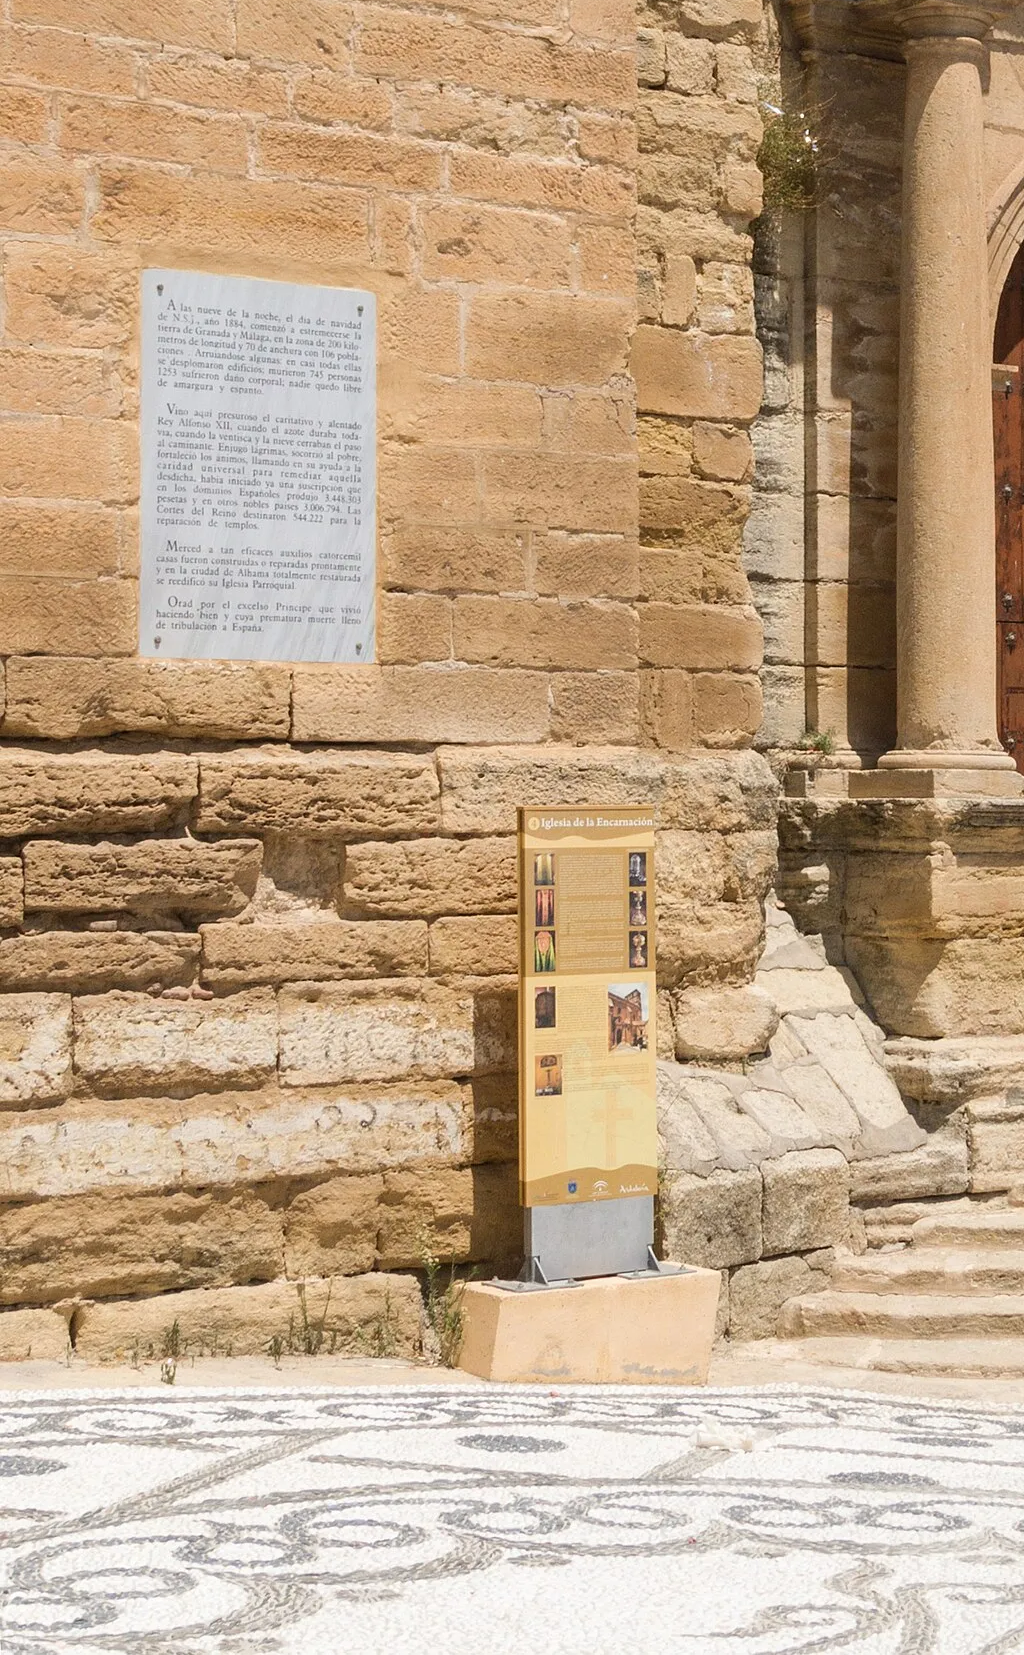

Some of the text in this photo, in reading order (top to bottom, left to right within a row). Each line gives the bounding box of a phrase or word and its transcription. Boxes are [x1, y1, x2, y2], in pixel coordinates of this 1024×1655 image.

[167, 299, 362, 330] A las nueve de la noche, el de navidad
[157, 312, 168, 321] de
[299, 329, 350, 339] estremecerse
[354, 332, 362, 340] la
[158, 324, 181, 333] tierra
[195, 326, 231, 338] Granada
[286, 336, 293, 344] la
[328, 340, 342, 348] 200
[344, 341, 362, 350] kilo-
[157, 336, 186, 345] metros
[201, 338, 236, 349] longitud
[246, 342, 256, 350] 70
[257, 344, 267, 352] de
[270, 346, 302, 356] anchura
[322, 350, 335, 358] 106
[337, 352, 362, 361] pobla-
[170, 358, 224, 370] desplomaron
[227, 363, 264, 374] edificios;
[268, 368, 306, 377] murieron
[310, 370, 324, 379] 745
[328, 374, 362, 382] personas
[319, 361, 340, 369] todas
[344, 363, 362, 372] ellas
[157, 378, 168, 387] de
[174, 382, 214, 391] amargura
[158, 367, 177, 376] 1253
[182, 370, 220, 380] sufrieron
[248, 377, 285, 387] corporal;
[288, 380, 311, 388] nadie
[343, 384, 362, 393] libre
[167, 403, 189, 415] Vino
[218, 412, 258, 421] presuroso
[262, 414, 270, 422] el
[275, 417, 314, 426] caritativo
[328, 420, 362, 430] alentado
[157, 416, 174, 427] Rey
[179, 418, 211, 428] Alfonso
[237, 424, 267, 432] cuando
[271, 425, 279, 434] el
[309, 427, 337, 438] duraba
[342, 432, 361, 440] toda-
[175, 430, 206, 439] cuando
[219, 434, 252, 442] ventisca
[262, 435, 270, 444] la
[296, 440, 332, 448] cerraban
[157, 439, 165, 447] al
[326, 452, 334, 460] al
[337, 451, 362, 462] pobre,
[200, 453, 212, 461] los
[252, 456, 290, 467] llamando
[319, 463, 343, 471] ayuda
[157, 462, 193, 471] caridad
[201, 466, 245, 474] universal
[280, 471, 321, 480] remediar
[329, 474, 362, 483] aquella
[157, 472, 196, 482] desdicha,
[228, 478, 262, 486] iniciado
[265, 481, 275, 489] ya
[174, 483, 186, 492] los
[193, 485, 232, 494] dominios
[286, 492, 318, 502] produjo
[156, 504, 184, 514] Cortes
[191, 507, 205, 516] del
[212, 508, 237, 518] Reino
[243, 510, 286, 521] destinaron
[354, 517, 362, 526] la
[157, 496, 187, 504] pesetas
[243, 500, 269, 508] nobles
[347, 506, 362, 515] Las
[208, 519, 218, 527] de
[166, 540, 202, 553] Merced
[241, 546, 274, 556] eficaces
[280, 549, 313, 558] auxilios
[319, 552, 362, 561] catorcemil
[181, 555, 208, 564] fueron
[269, 560, 308, 569] reparadas
[311, 563, 361, 572] prontamente
[191, 567, 220, 576] ciudad
[223, 568, 234, 576] de
[238, 568, 269, 578] Alhama
[273, 571, 316, 580] totalmente
[320, 574, 361, 582] restaurada
[222, 578, 249, 589] Iglesia
[167, 596, 193, 608] Orad
[200, 602, 215, 610] por
[222, 601, 230, 609] el
[237, 602, 269, 610] excelso
[156, 609, 194, 618] haciendo
[199, 611, 218, 620] bien
[234, 614, 254, 622] cuya
[156, 620, 263, 633] de España.
[541, 817, 572, 830] Iglesia
[573, 817, 584, 827] de
[586, 817, 595, 827] la
[596, 816, 653, 826] Encarnación
